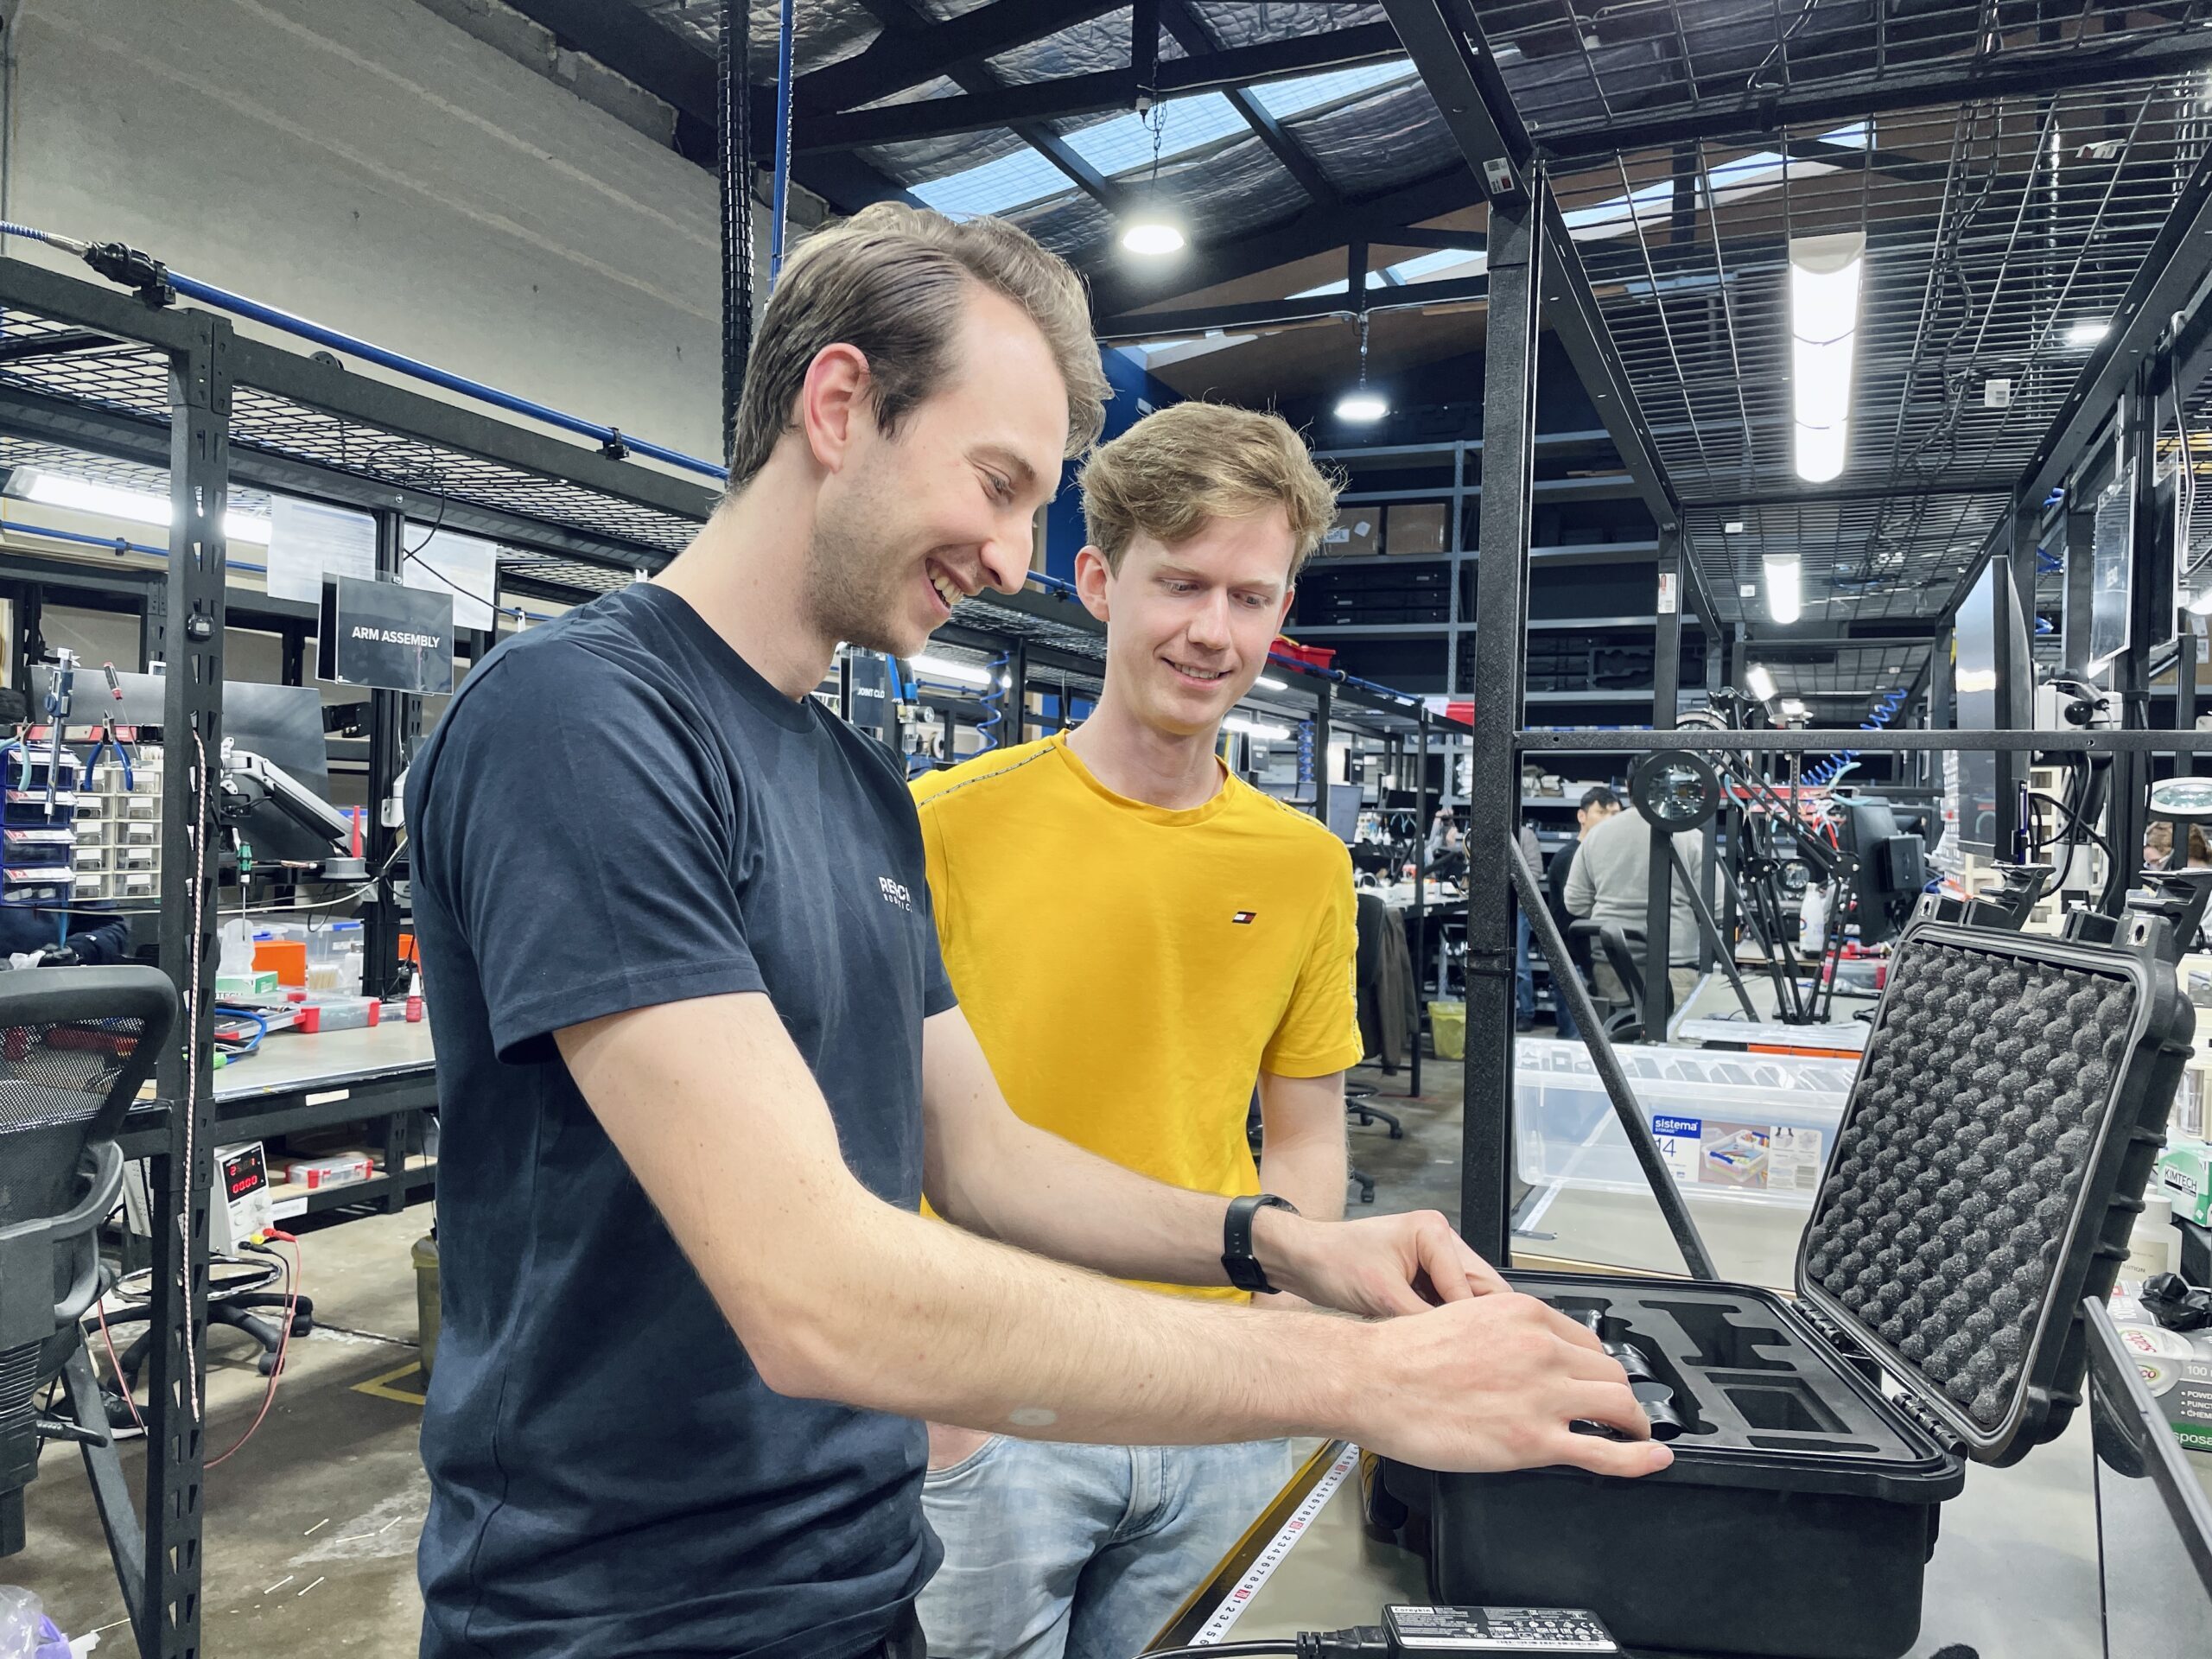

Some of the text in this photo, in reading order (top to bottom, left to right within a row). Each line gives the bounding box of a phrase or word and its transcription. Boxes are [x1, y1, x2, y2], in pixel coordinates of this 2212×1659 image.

[352, 626, 441, 648] ARM ASSEMBLY
[857, 687, 874, 697] JOINT
[1655, 1118, 1698, 1131] sistema
[1656, 1137, 1676, 1158] 14
[2164, 1167, 2197, 1192] KIMTECH
[2187, 1365, 2208, 1376] 100
